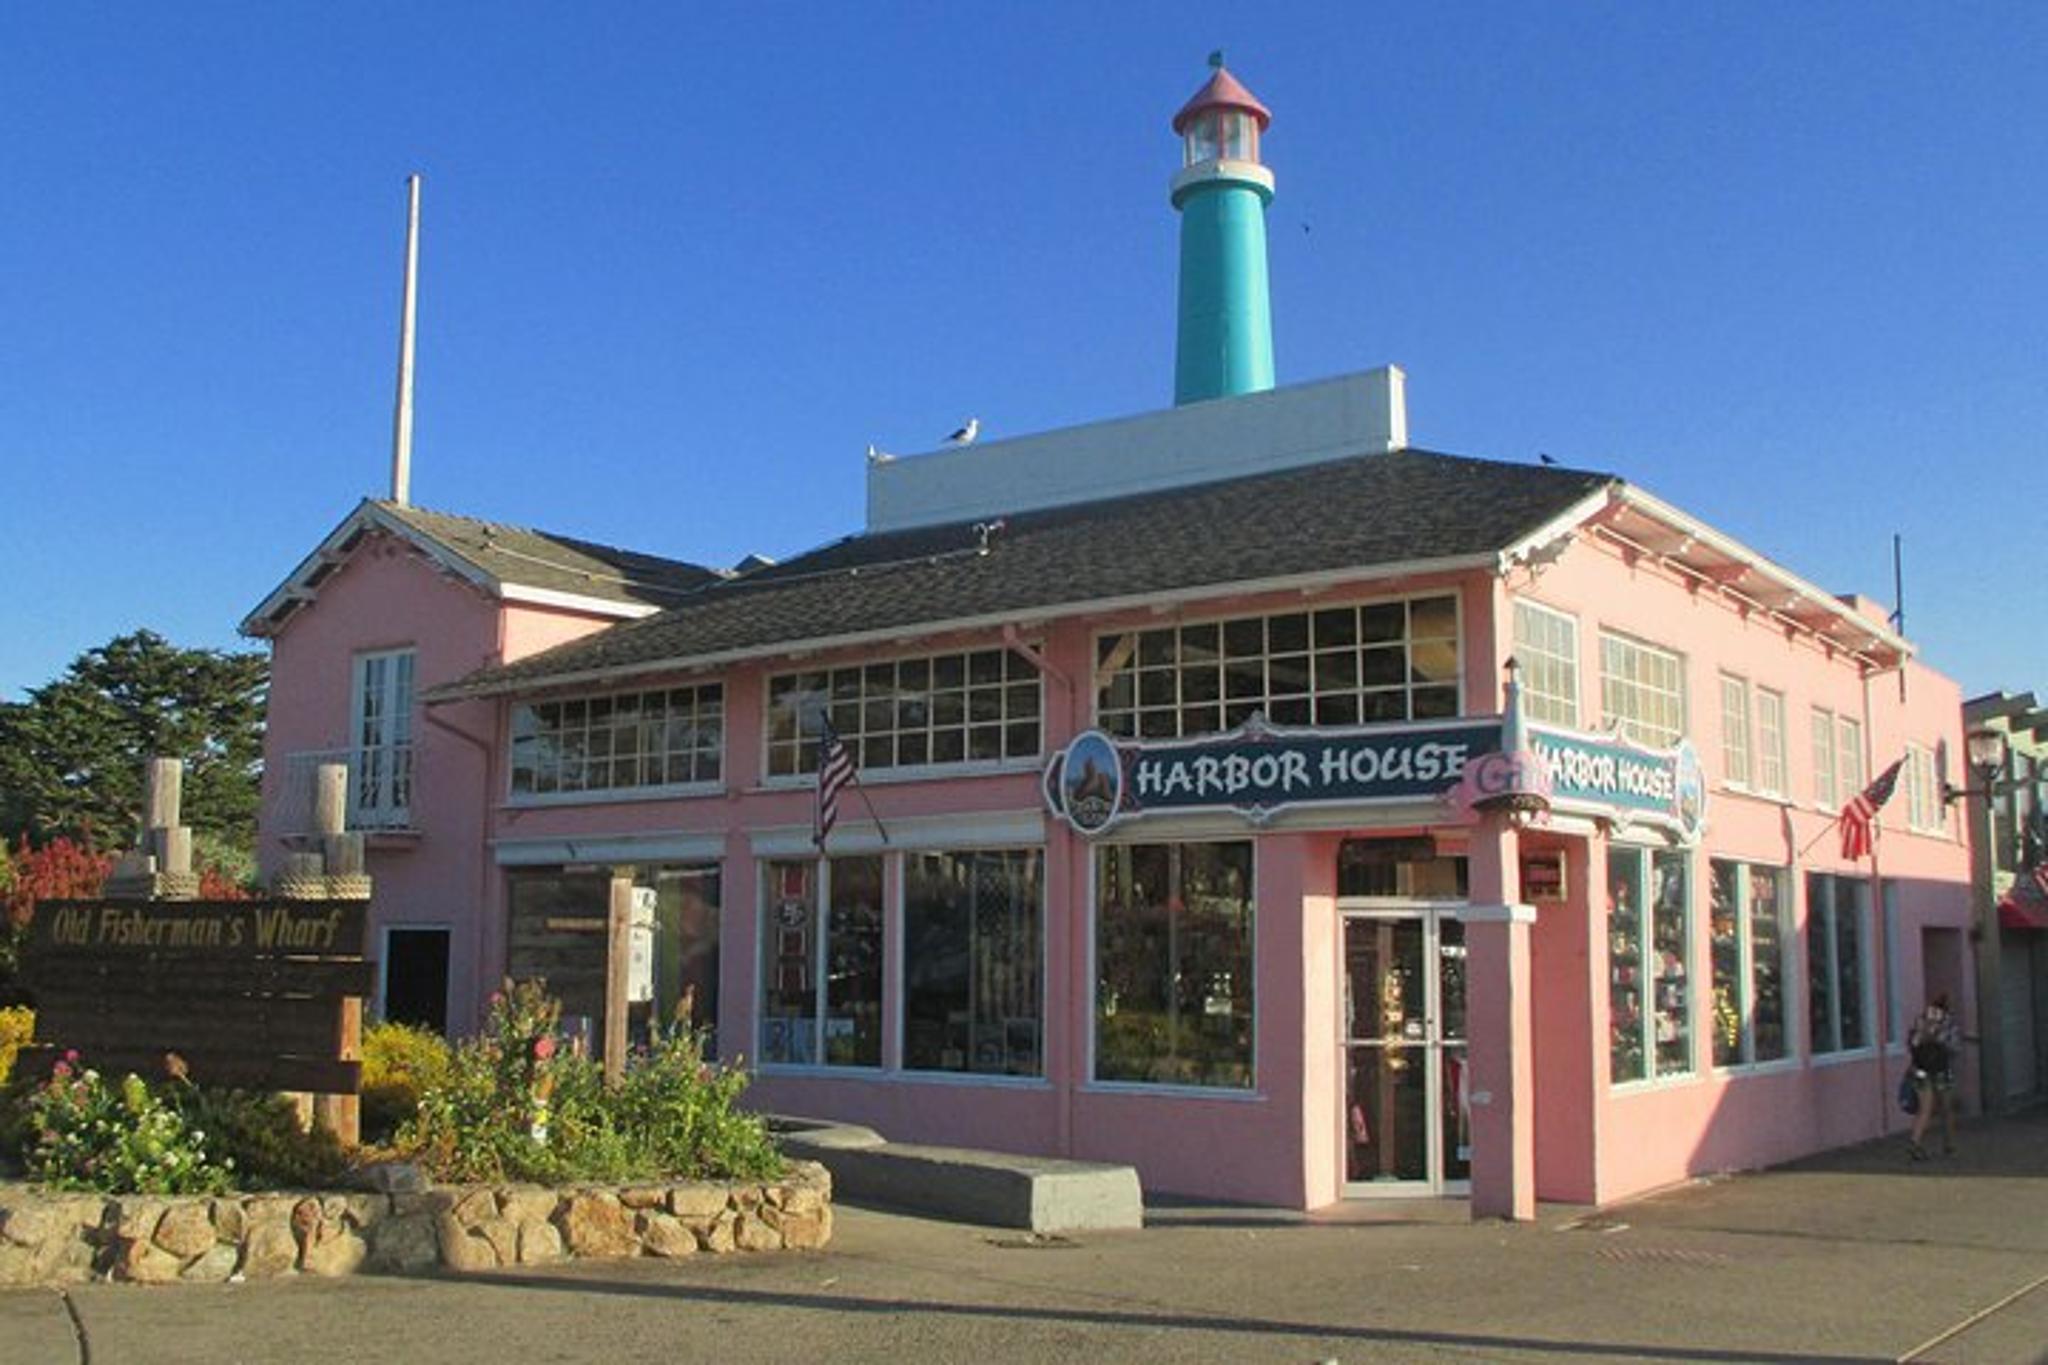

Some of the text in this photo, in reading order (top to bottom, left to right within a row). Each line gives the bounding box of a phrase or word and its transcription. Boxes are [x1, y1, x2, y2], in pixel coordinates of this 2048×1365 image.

[1136, 750, 1311, 797] HARBOR
[1319, 741, 1469, 786] HOUSE
[1534, 740, 1617, 795] HARBOR
[1618, 758, 1674, 801] HOUSE
[53, 908, 343, 949] Old Fisherman's Wharf
